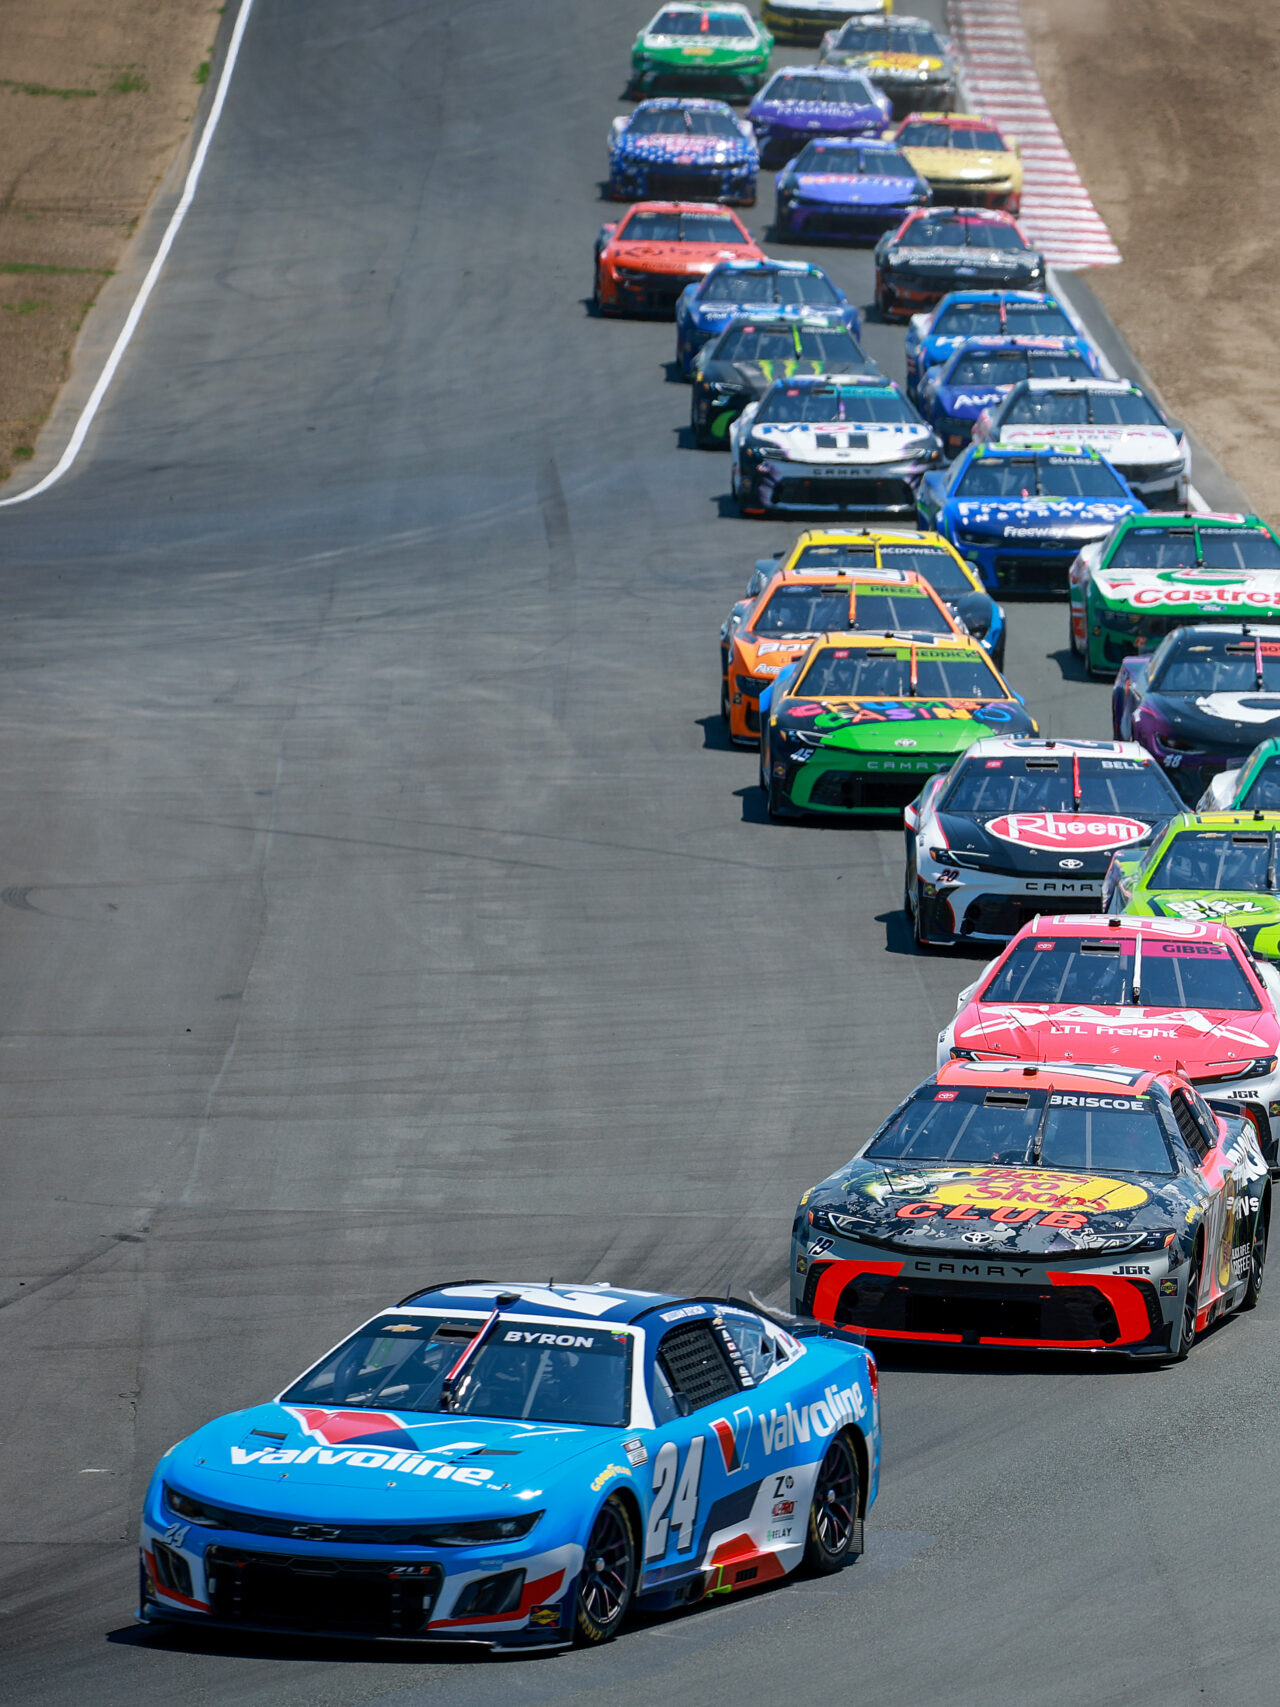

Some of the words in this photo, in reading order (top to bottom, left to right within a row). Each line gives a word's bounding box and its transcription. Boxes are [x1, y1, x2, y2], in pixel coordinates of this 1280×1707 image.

[1003, 526, 1068, 538] Freeway
[790, 748, 815, 762] 45
[1163, 754, 1183, 768] 48
[866, 761, 951, 771] CAMRY
[1101, 760, 1145, 771] BELL
[1005, 812, 1141, 841] Rheem
[937, 869, 959, 883] 20
[1161, 943, 1224, 956] GIBBS
[1050, 1025, 1089, 1034] LTL
[1095, 1025, 1180, 1039] Freight
[1227, 1090, 1260, 1099] JGR
[1050, 1094, 1145, 1111] BRISCOE
[976, 1168, 1091, 1183] Bass
[974, 1177, 1061, 1191] Pro
[963, 1185, 1110, 1212] Shops
[896, 1202, 1089, 1229] CLUB
[808, 1236, 836, 1256] 19
[914, 1261, 1033, 1278] CAMRY
[1112, 1265, 1152, 1275] JGR
[503, 1330, 594, 1349] BYRON
[645, 1434, 705, 1566] 24
[160, 1522, 193, 1549] 24
[772, 1527, 793, 1539] RELAY
[391, 1565, 432, 1576] ZL1
